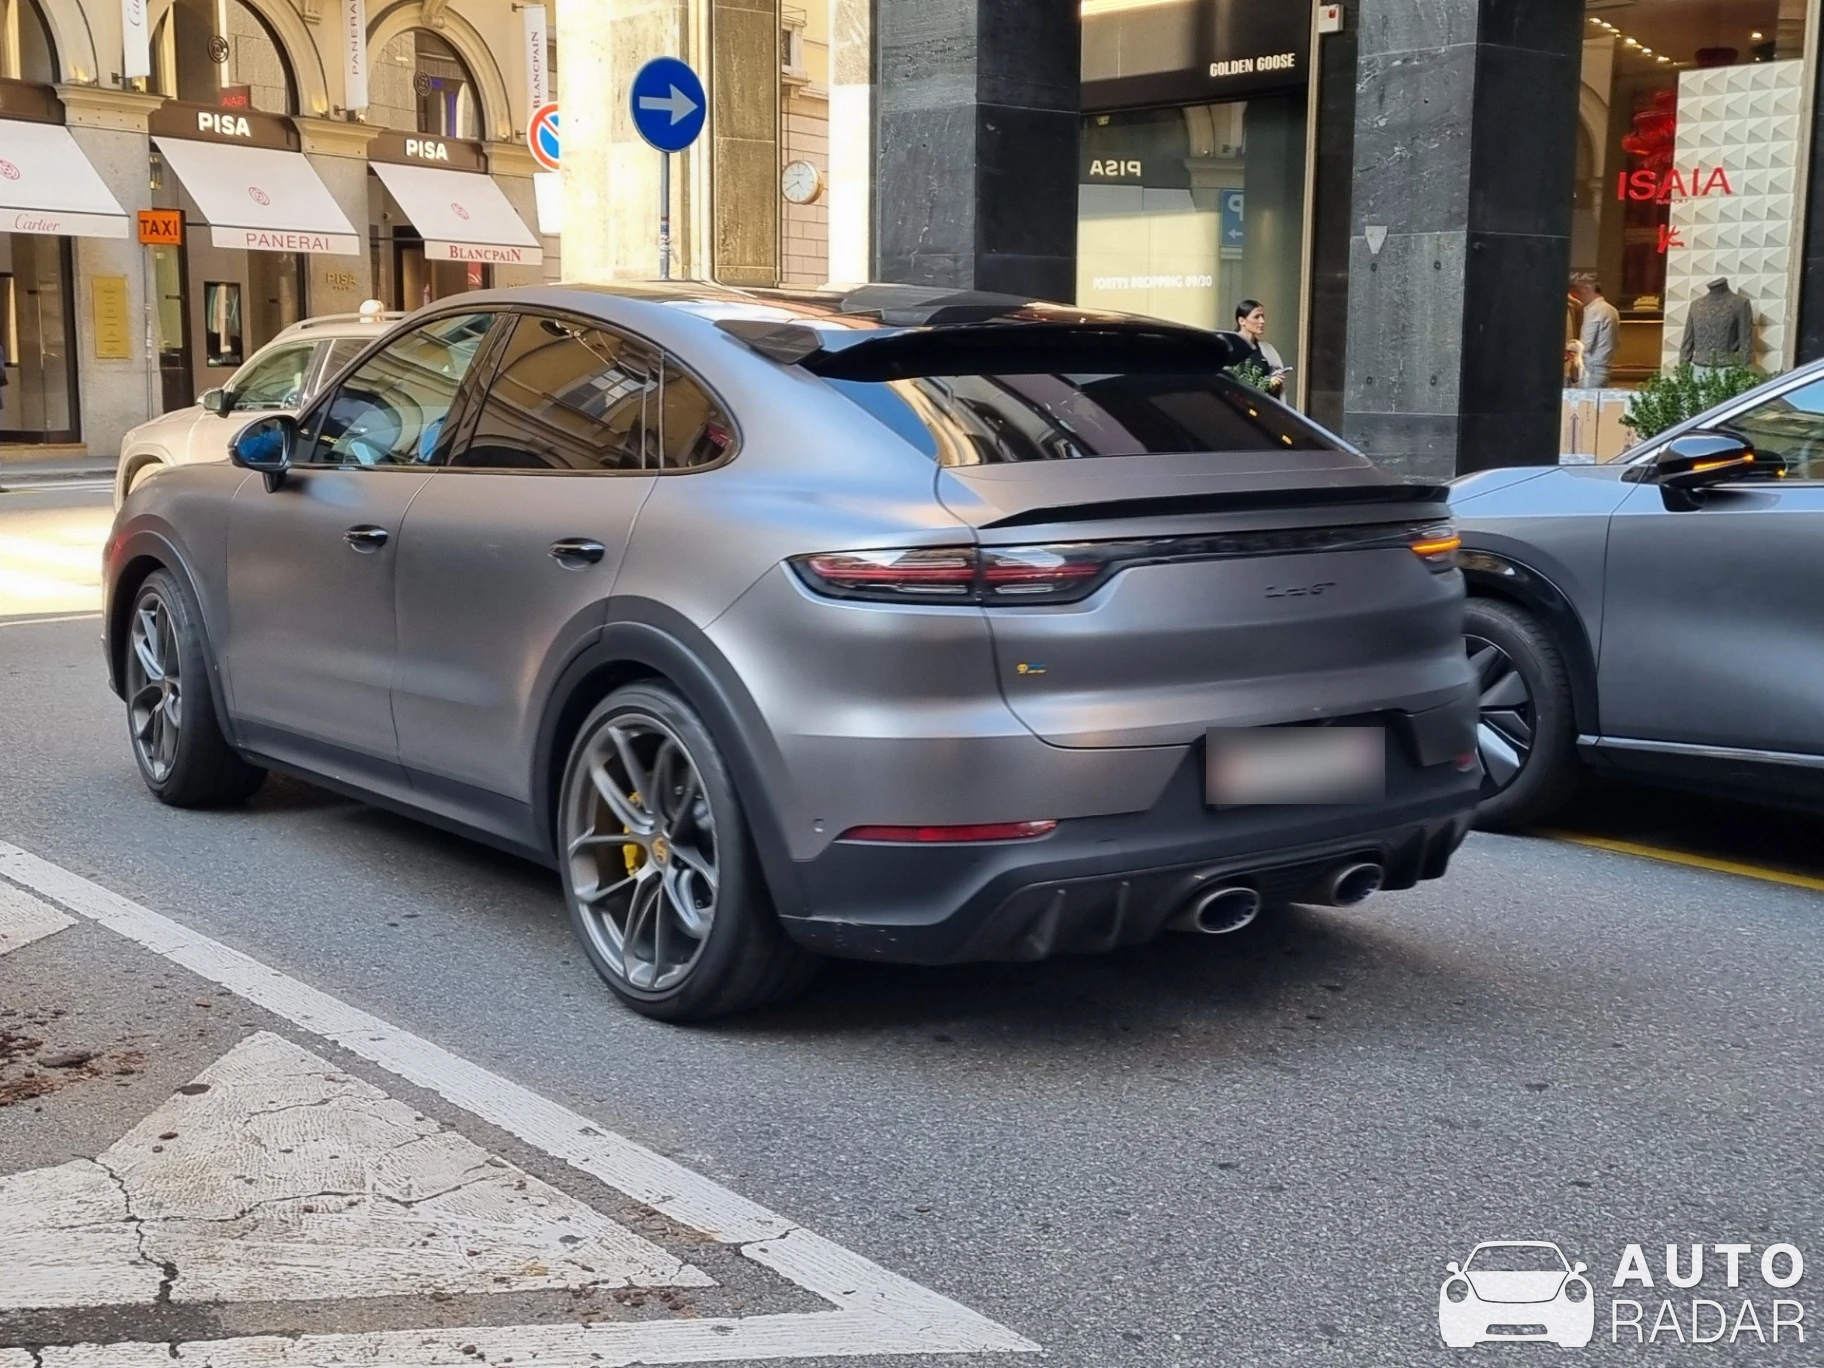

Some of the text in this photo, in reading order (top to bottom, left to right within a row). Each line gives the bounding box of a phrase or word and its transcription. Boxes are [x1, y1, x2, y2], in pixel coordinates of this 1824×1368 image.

[531, 31, 541, 109] BLANCPAIN
[1209, 53, 1296, 78] GOLDEN GOOSE
[198, 111, 251, 137] PISA
[405, 139, 449, 161] PISA
[1617, 166, 1733, 201] ISAIA
[14, 212, 61, 231] Cartier
[140, 219, 178, 237] TAXI
[245, 232, 330, 251] PANERAI
[324, 272, 357, 286] PISA
